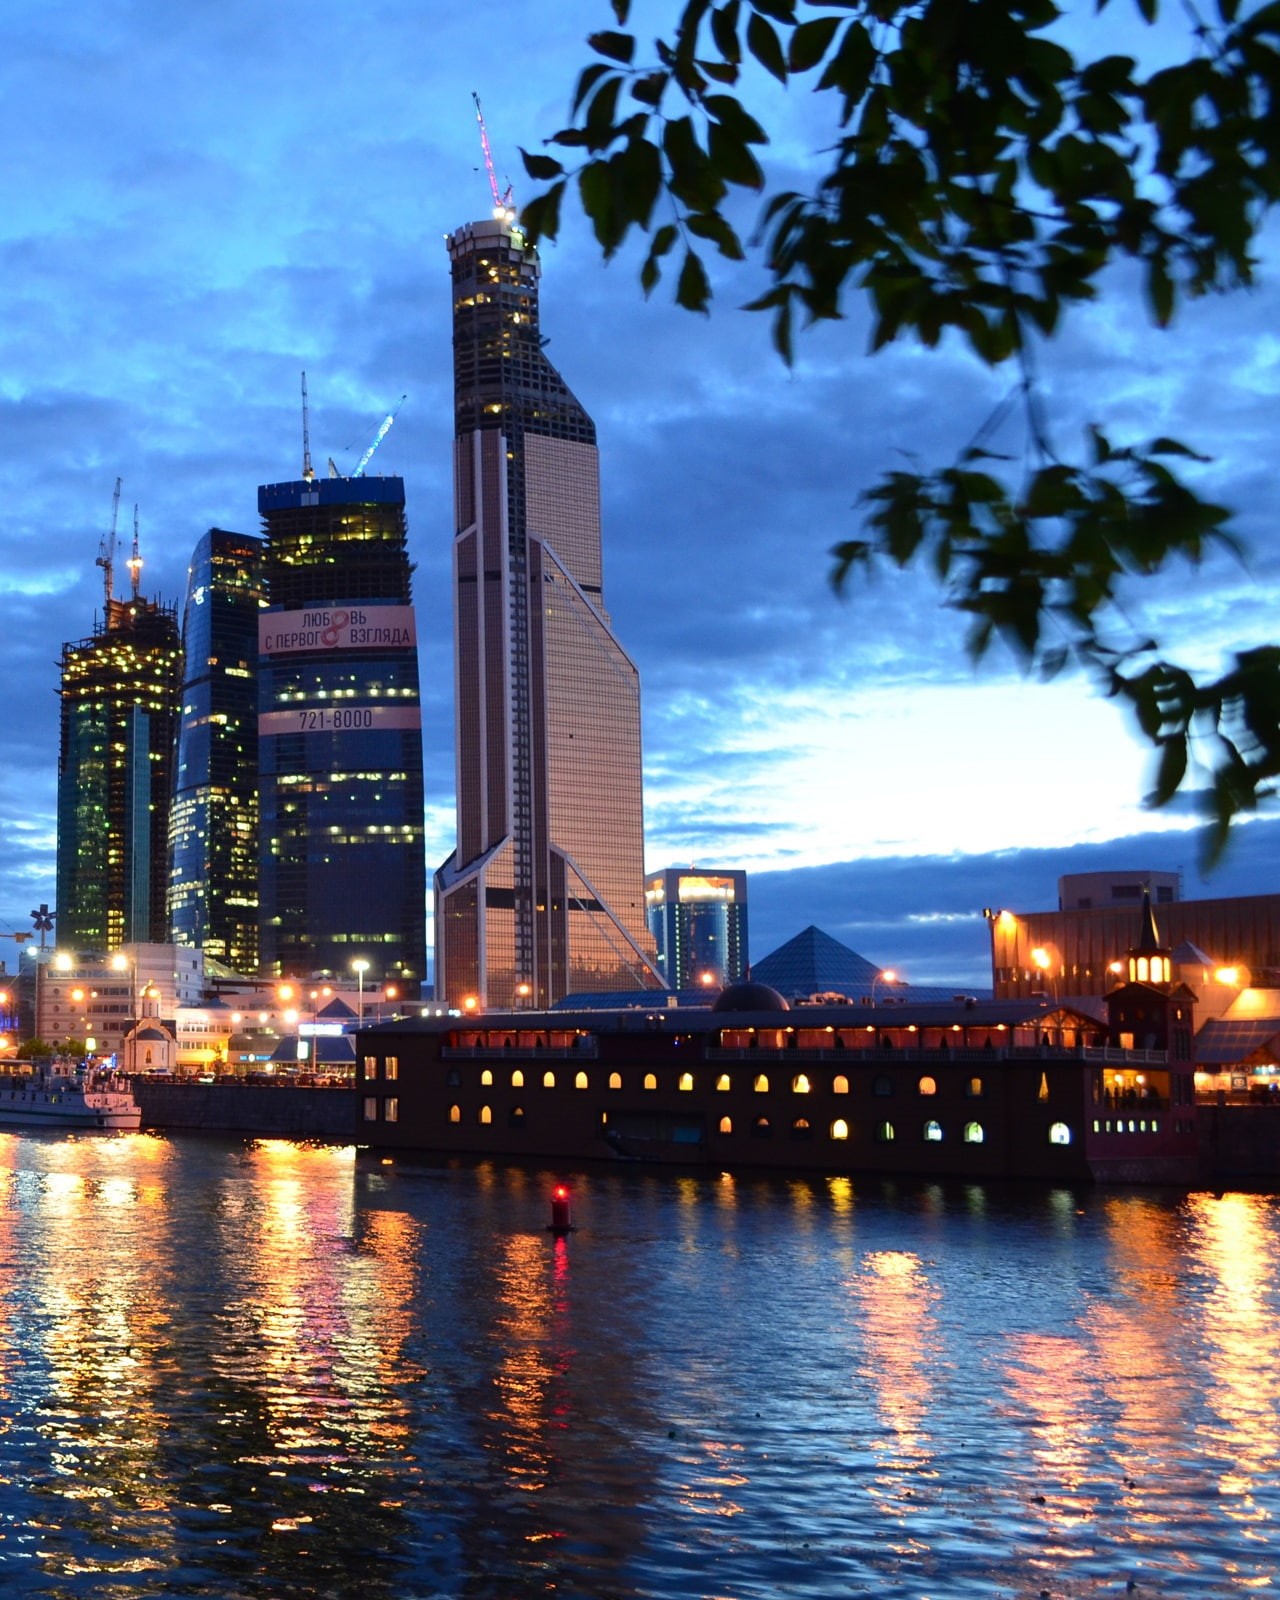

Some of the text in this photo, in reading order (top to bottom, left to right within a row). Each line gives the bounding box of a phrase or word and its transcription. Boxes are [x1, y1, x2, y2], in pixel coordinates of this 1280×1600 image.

[265, 636, 273, 650] С
[350, 628, 410, 644] ВЗГЛЯДА
[299, 710, 372, 729] 721-8000
